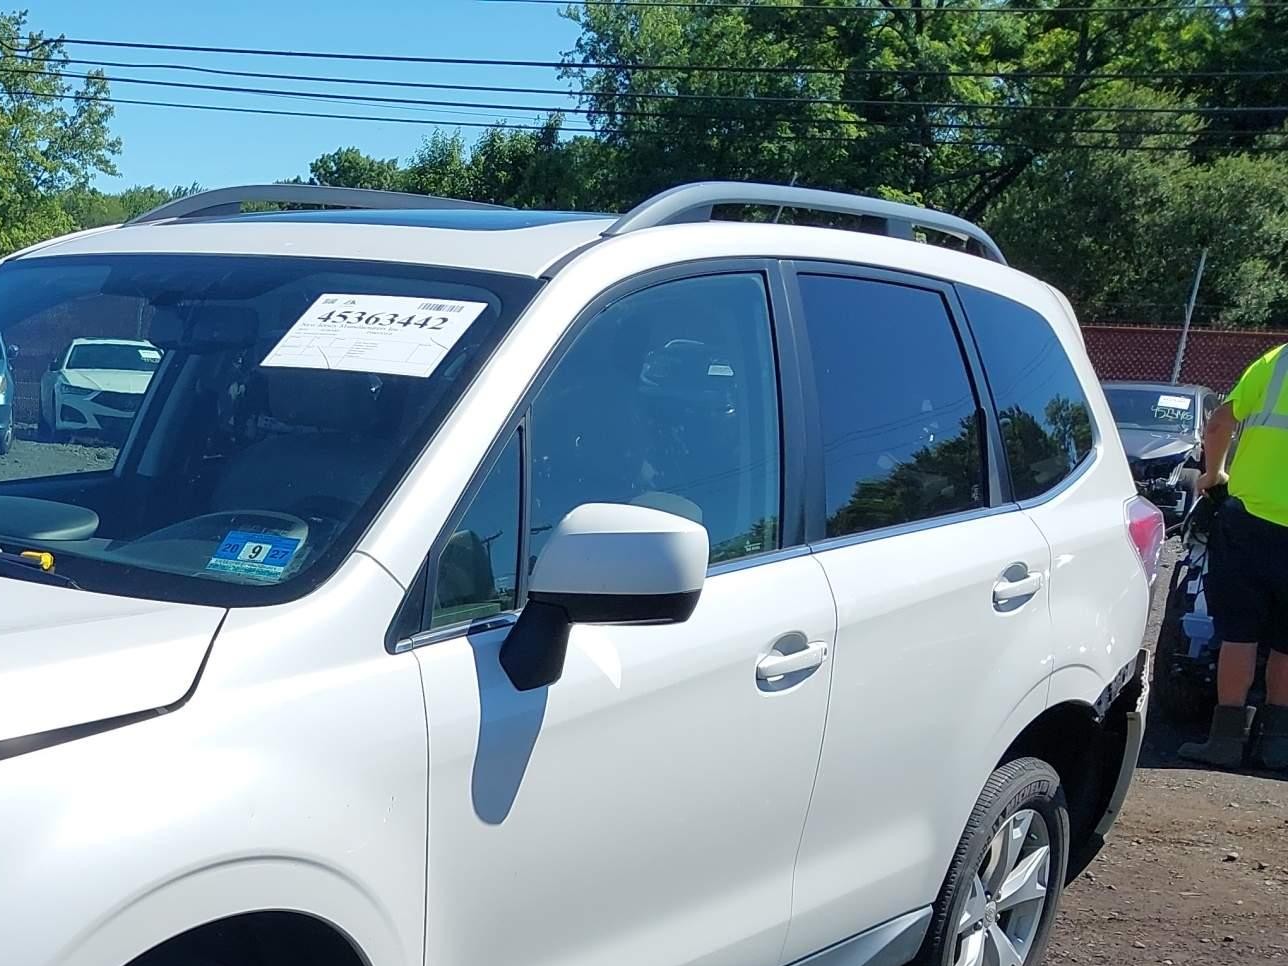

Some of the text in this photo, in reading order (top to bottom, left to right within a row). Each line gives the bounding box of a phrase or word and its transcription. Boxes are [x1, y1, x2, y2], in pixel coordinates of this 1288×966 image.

[317, 310, 449, 330] 45363442
[221, 543, 290, 560] 20 9 27
